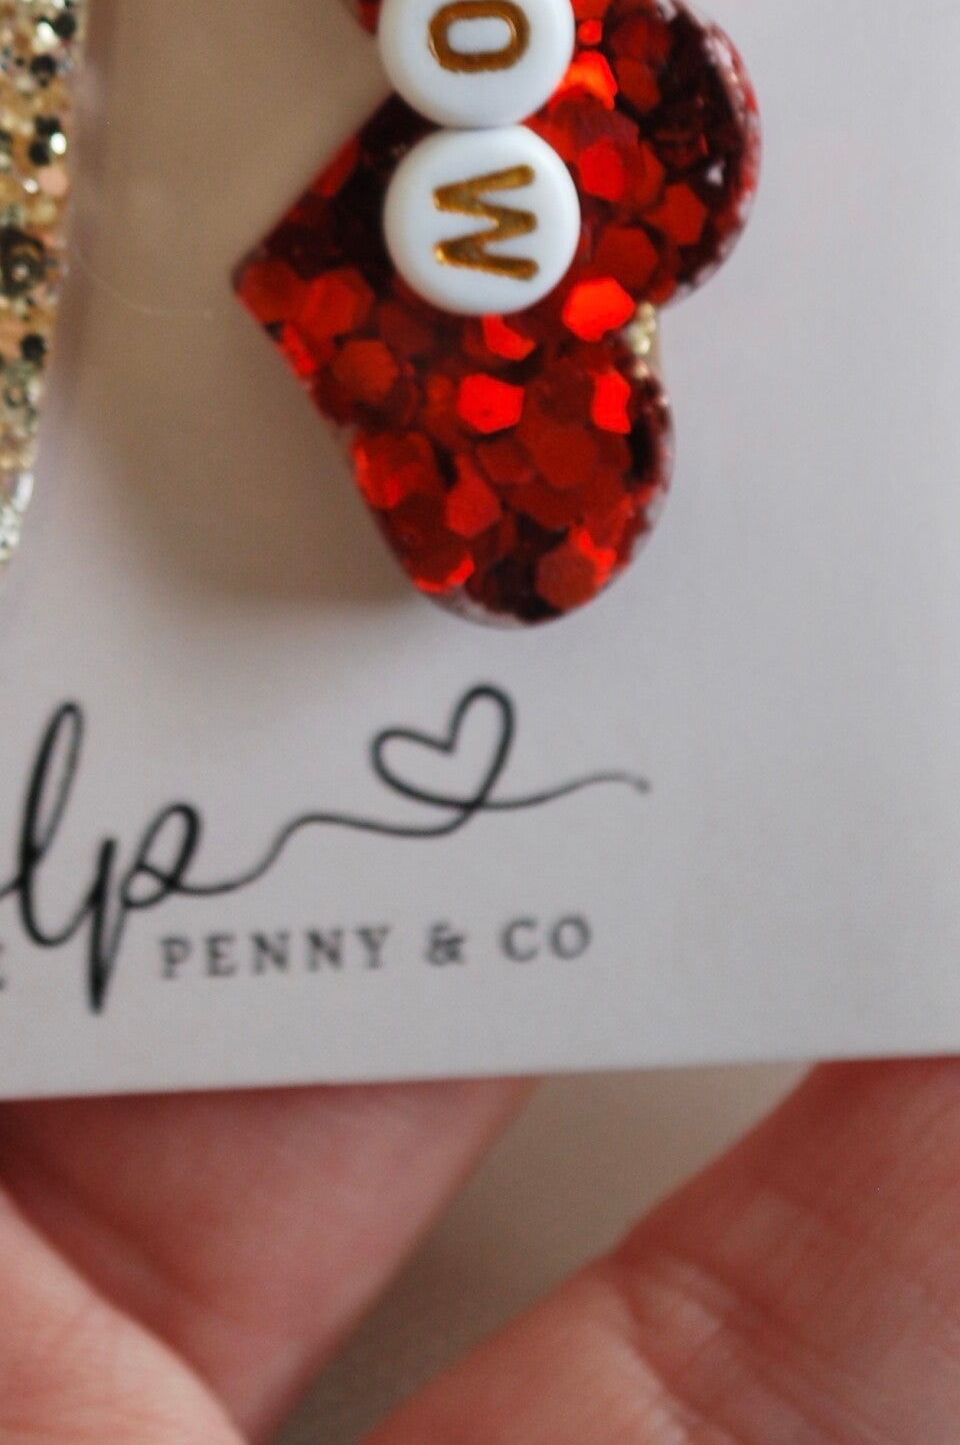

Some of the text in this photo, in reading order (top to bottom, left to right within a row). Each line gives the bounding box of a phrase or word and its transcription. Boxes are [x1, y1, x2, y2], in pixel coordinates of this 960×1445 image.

[160, 923, 396, 981] PENNY
[425, 920, 467, 967] &
[500, 915, 595, 963] CO
